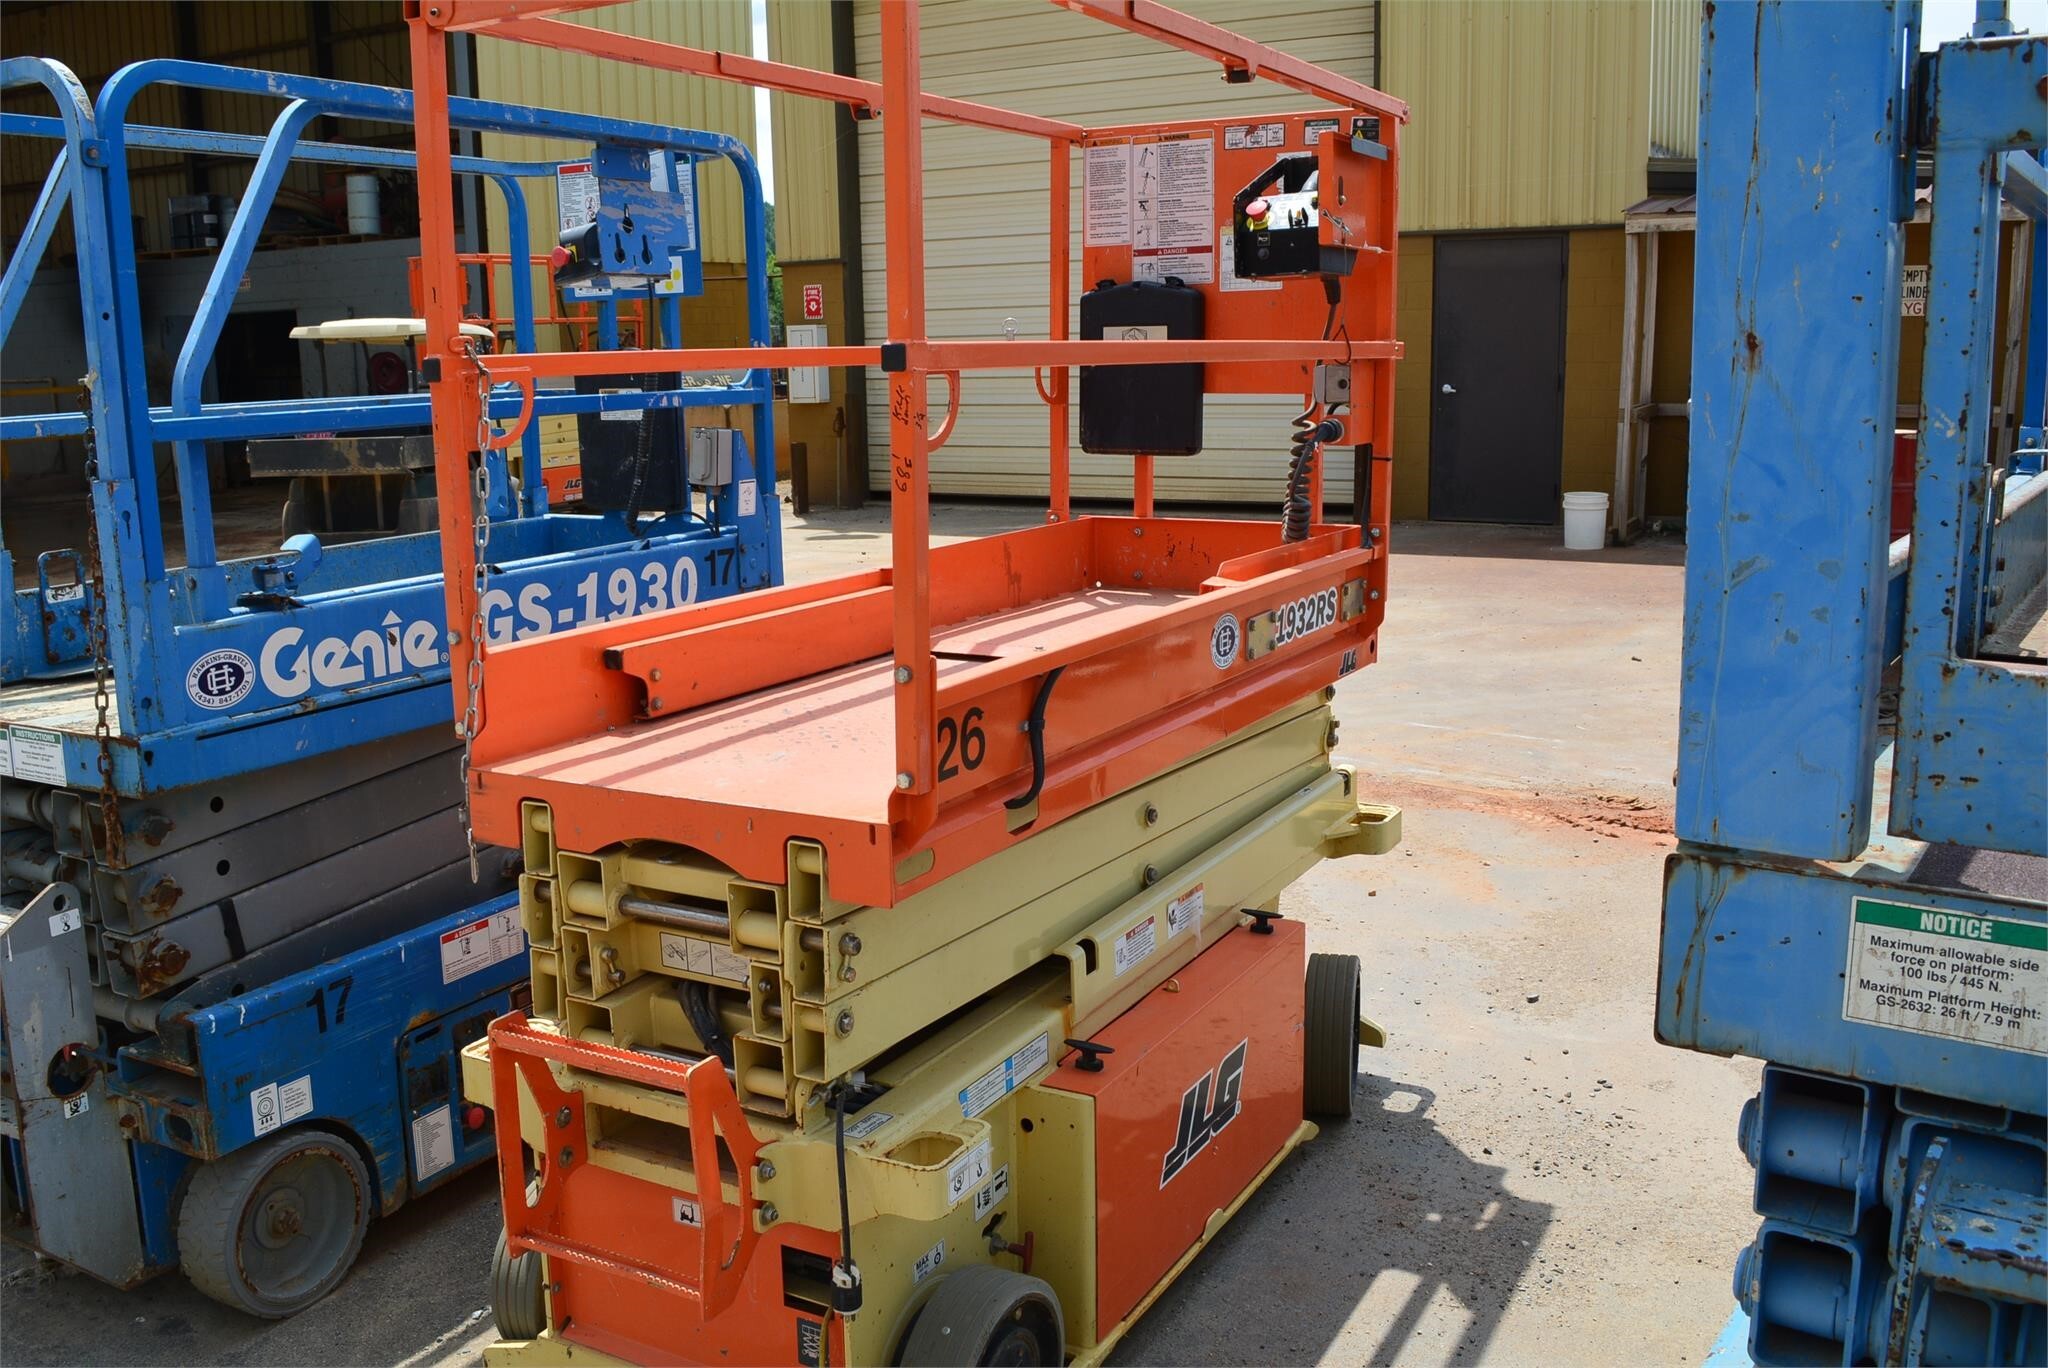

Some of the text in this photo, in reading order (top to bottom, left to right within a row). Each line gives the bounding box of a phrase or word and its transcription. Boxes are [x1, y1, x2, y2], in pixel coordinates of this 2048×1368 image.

[704, 548, 735, 586] 17
[482, 555, 698, 646] GS-1930
[1276, 587, 1337, 645] 1932RS
[192, 653, 249, 679] HAWKINS-GRAVES
[260, 610, 440, 698] Genie
[1338, 648, 1357, 676] JLG
[15, 729, 56, 742] INSTRUCTIONS
[938, 707, 985, 783] 26
[1920, 912, 1993, 940] NOTICE
[1870, 935, 2040, 972] Maximum allowable side
[1890, 951, 2014, 982] force on platform:
[1900, 966, 2003, 993] 100 lbs / 445 N.
[306, 975, 354, 1034] 17
[1859, 978, 2041, 1020] Maximum Platform Height:
[1875, 994, 2021, 1030] GS-2632: 26 ft / 7.9 m
[1160, 1037, 1248, 1190] JLG
[915, 1253, 930, 1271] MAX
